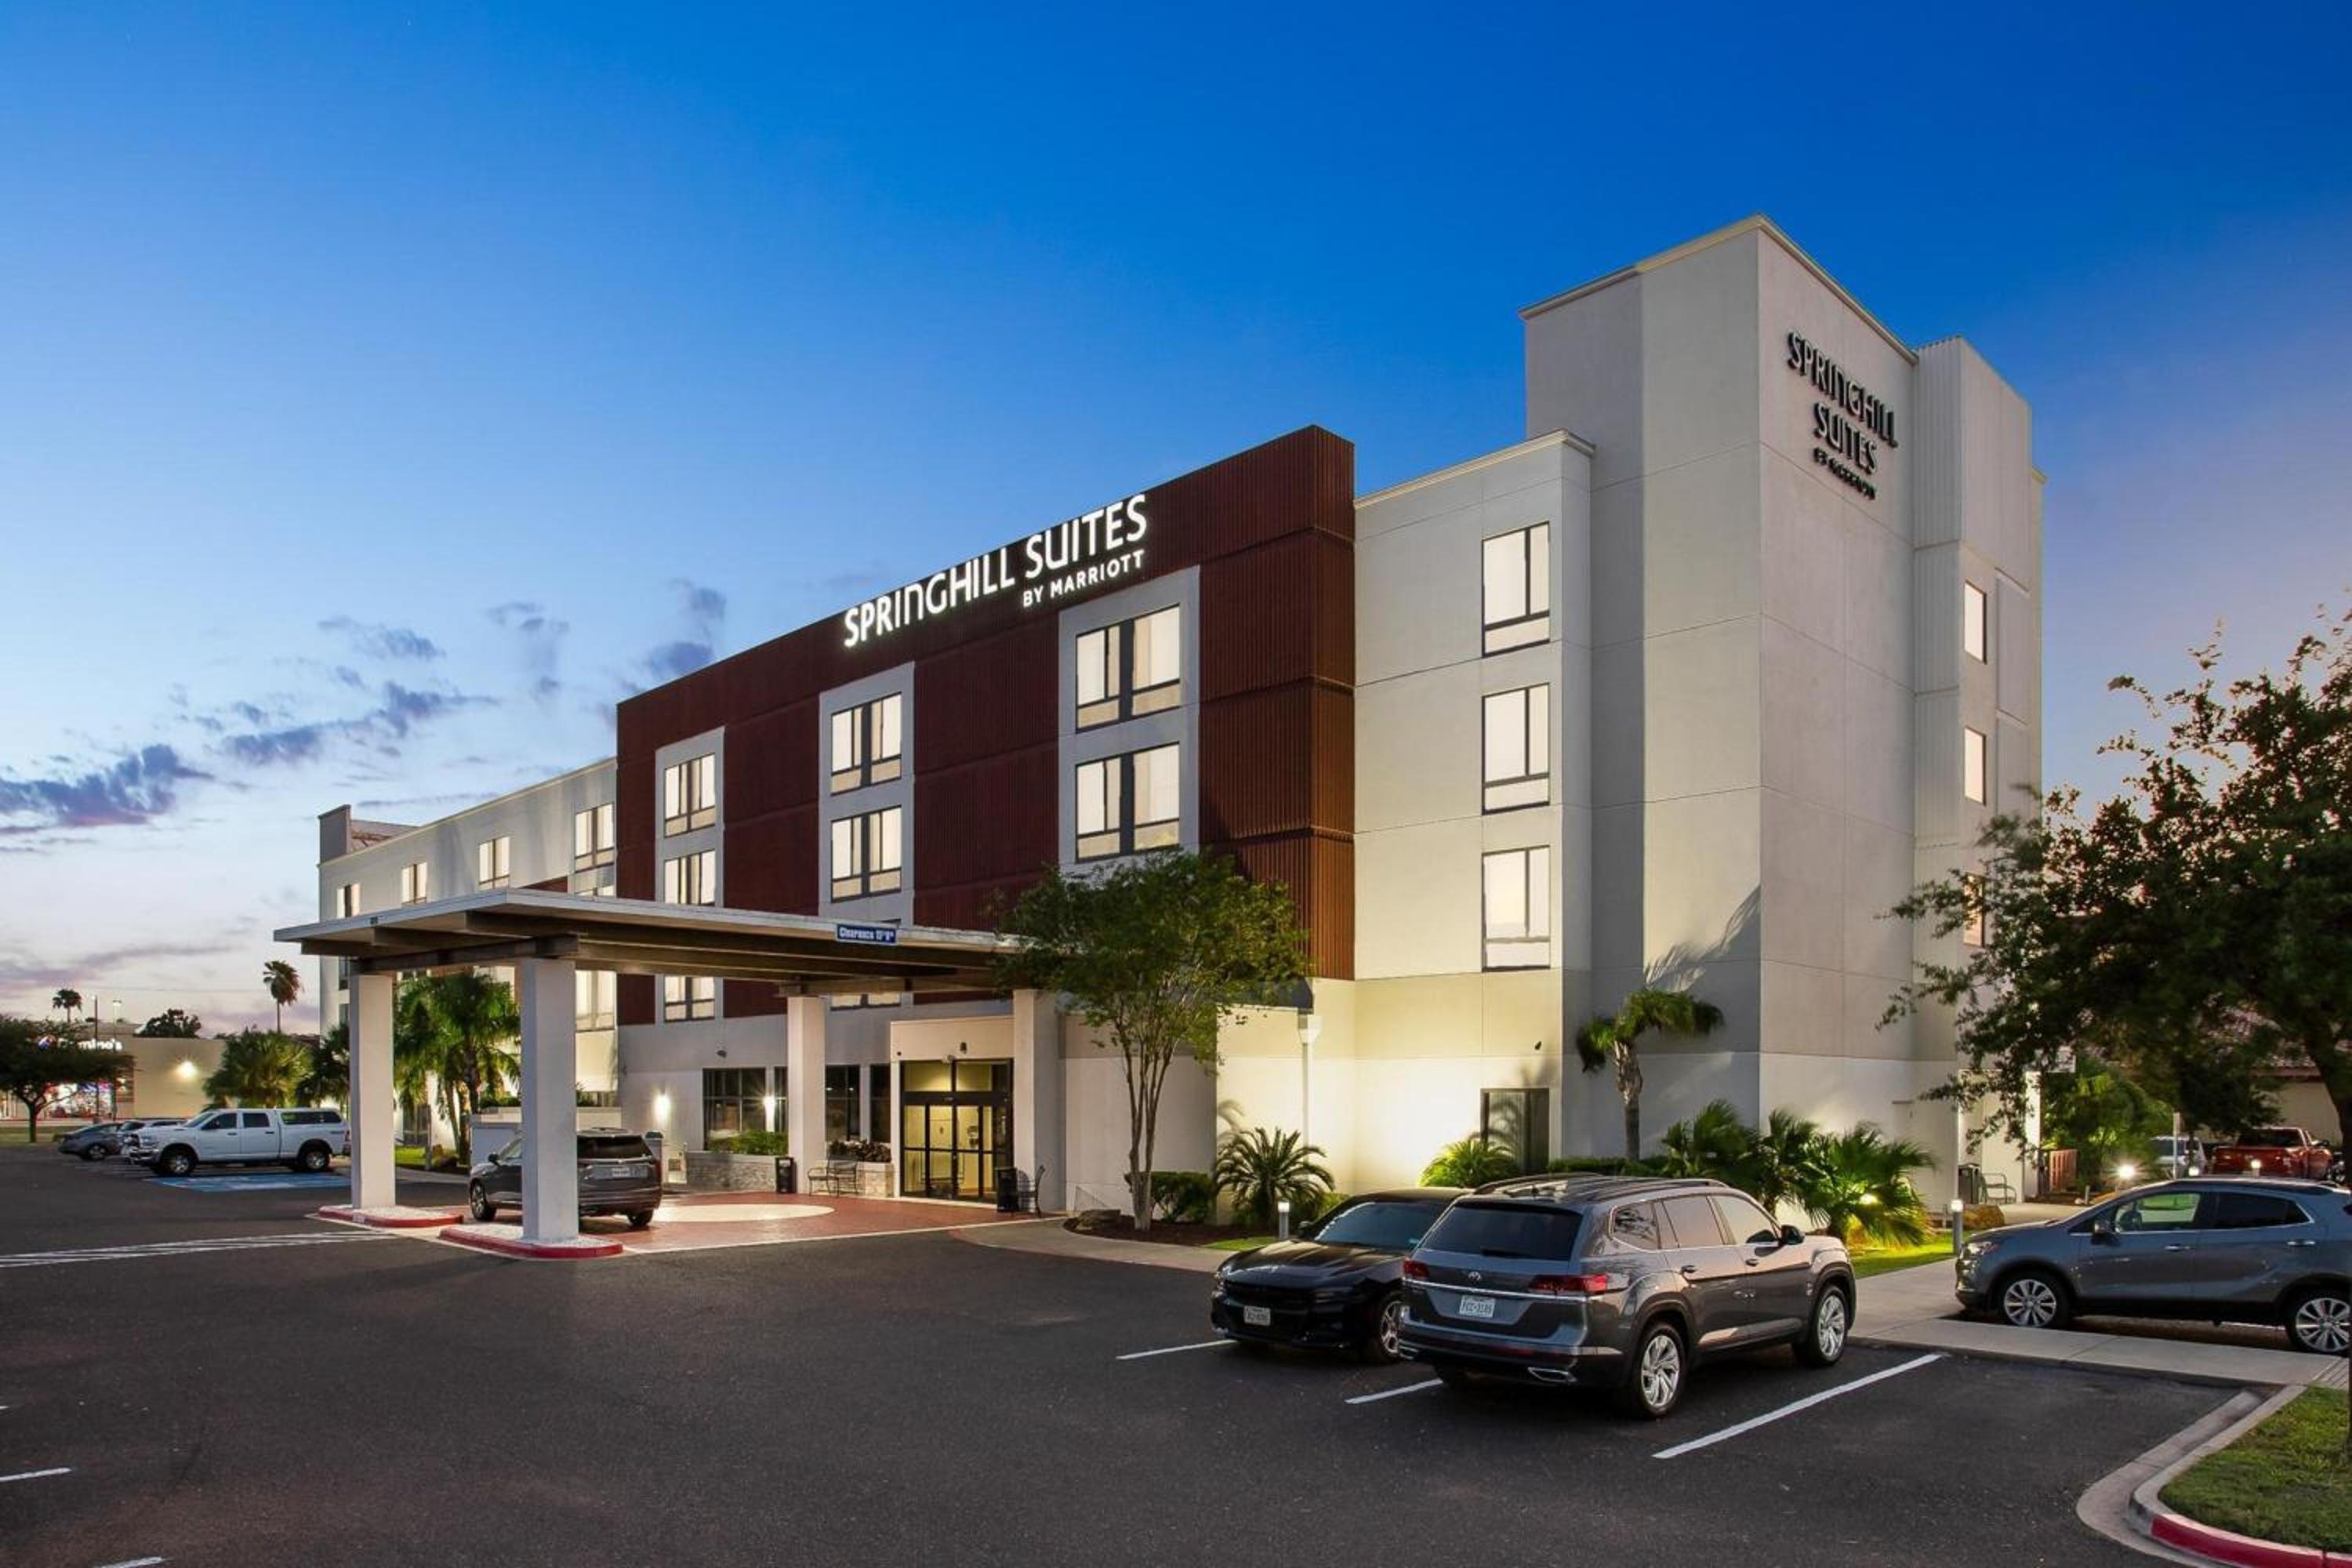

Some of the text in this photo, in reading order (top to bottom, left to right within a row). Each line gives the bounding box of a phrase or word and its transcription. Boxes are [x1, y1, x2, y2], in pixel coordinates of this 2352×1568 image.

[1788, 330, 1898, 448] SPRINGHILL
[1813, 401, 1878, 475] SUITES
[844, 494, 1147, 648] SPRINGHILL SUITES
[1022, 550, 1145, 608] BY MARRIOTT
[57, 1037, 122, 1051] Dmino's
